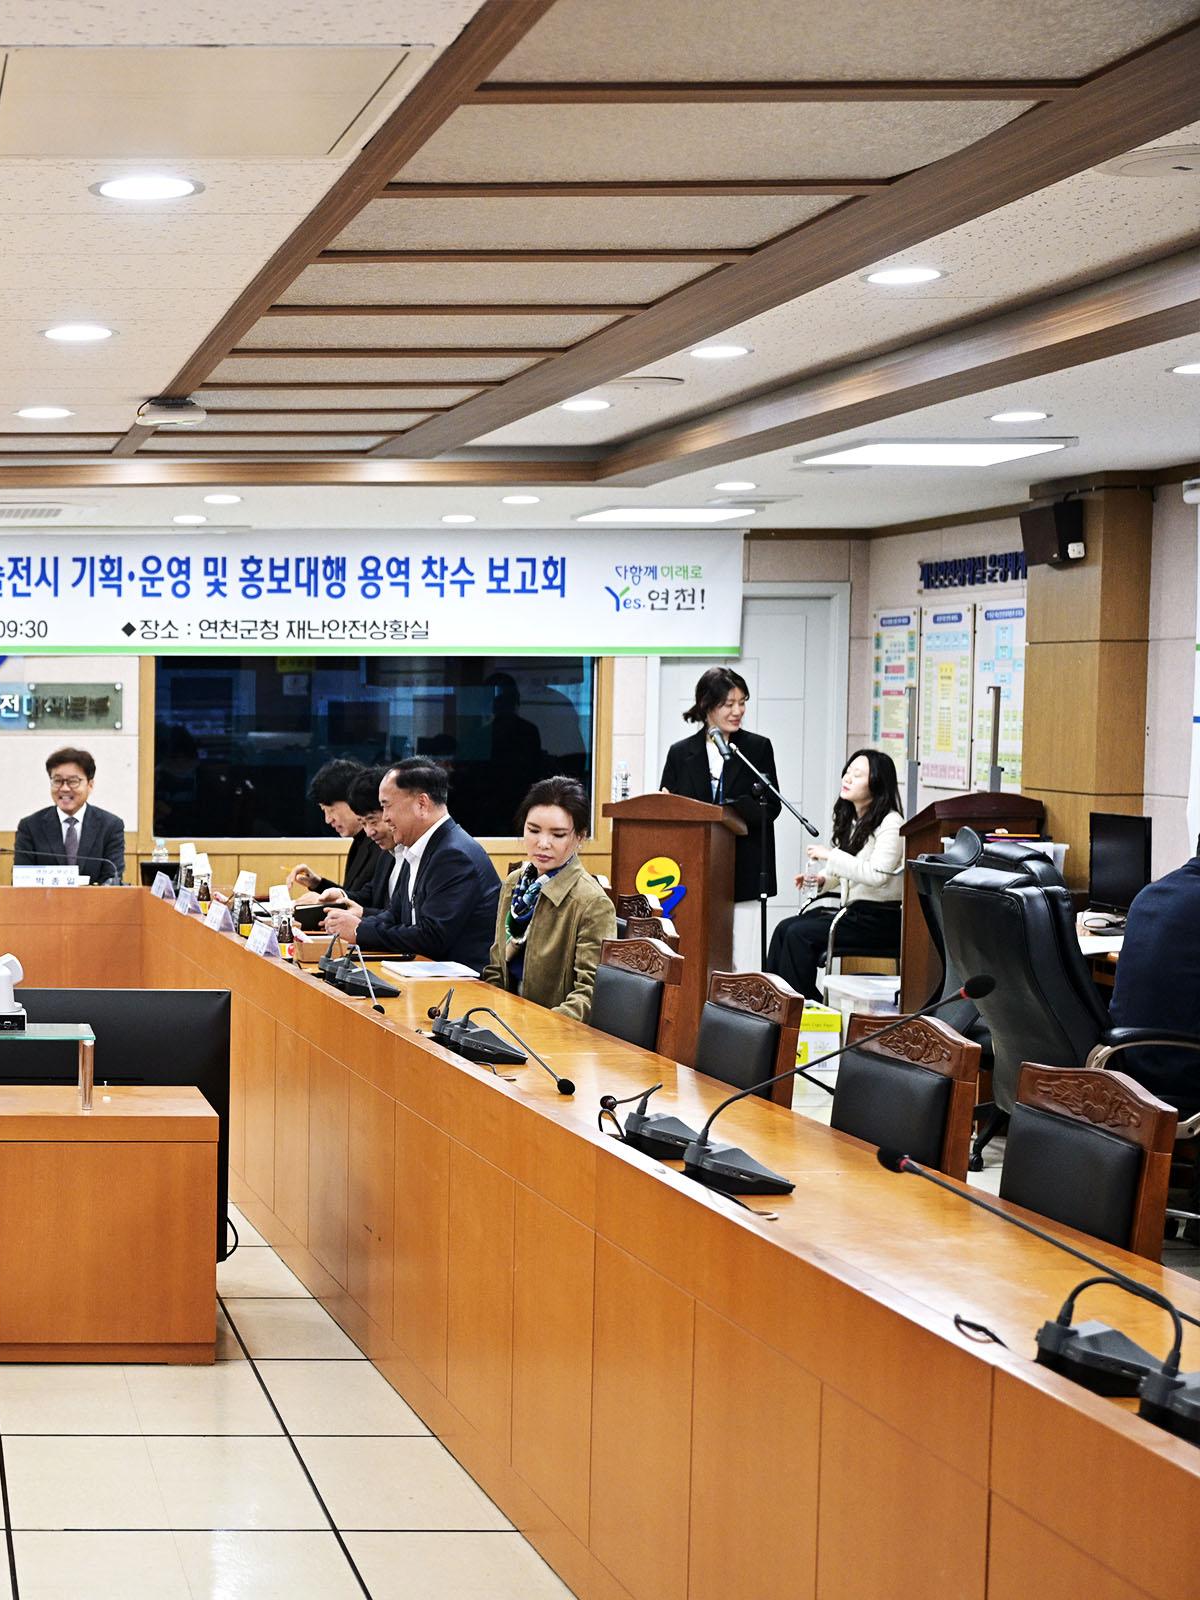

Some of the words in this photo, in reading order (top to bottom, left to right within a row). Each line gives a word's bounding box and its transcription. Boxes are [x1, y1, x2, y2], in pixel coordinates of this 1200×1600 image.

[71, 554, 191, 599] 기획·운영
[203, 556, 228, 599] 및
[238, 554, 347, 600] 홍보대행
[357, 555, 410, 600] 용역
[420, 555, 476, 598] 착수
[485, 555, 567, 599] 보고회
[615, 565, 658, 586] 다함께
[660, 565, 703, 580] 미래로
[139, 619, 179, 640] 장소
[198, 619, 279, 640] 연천군청
[286, 619, 429, 640] 재난안전상황실
